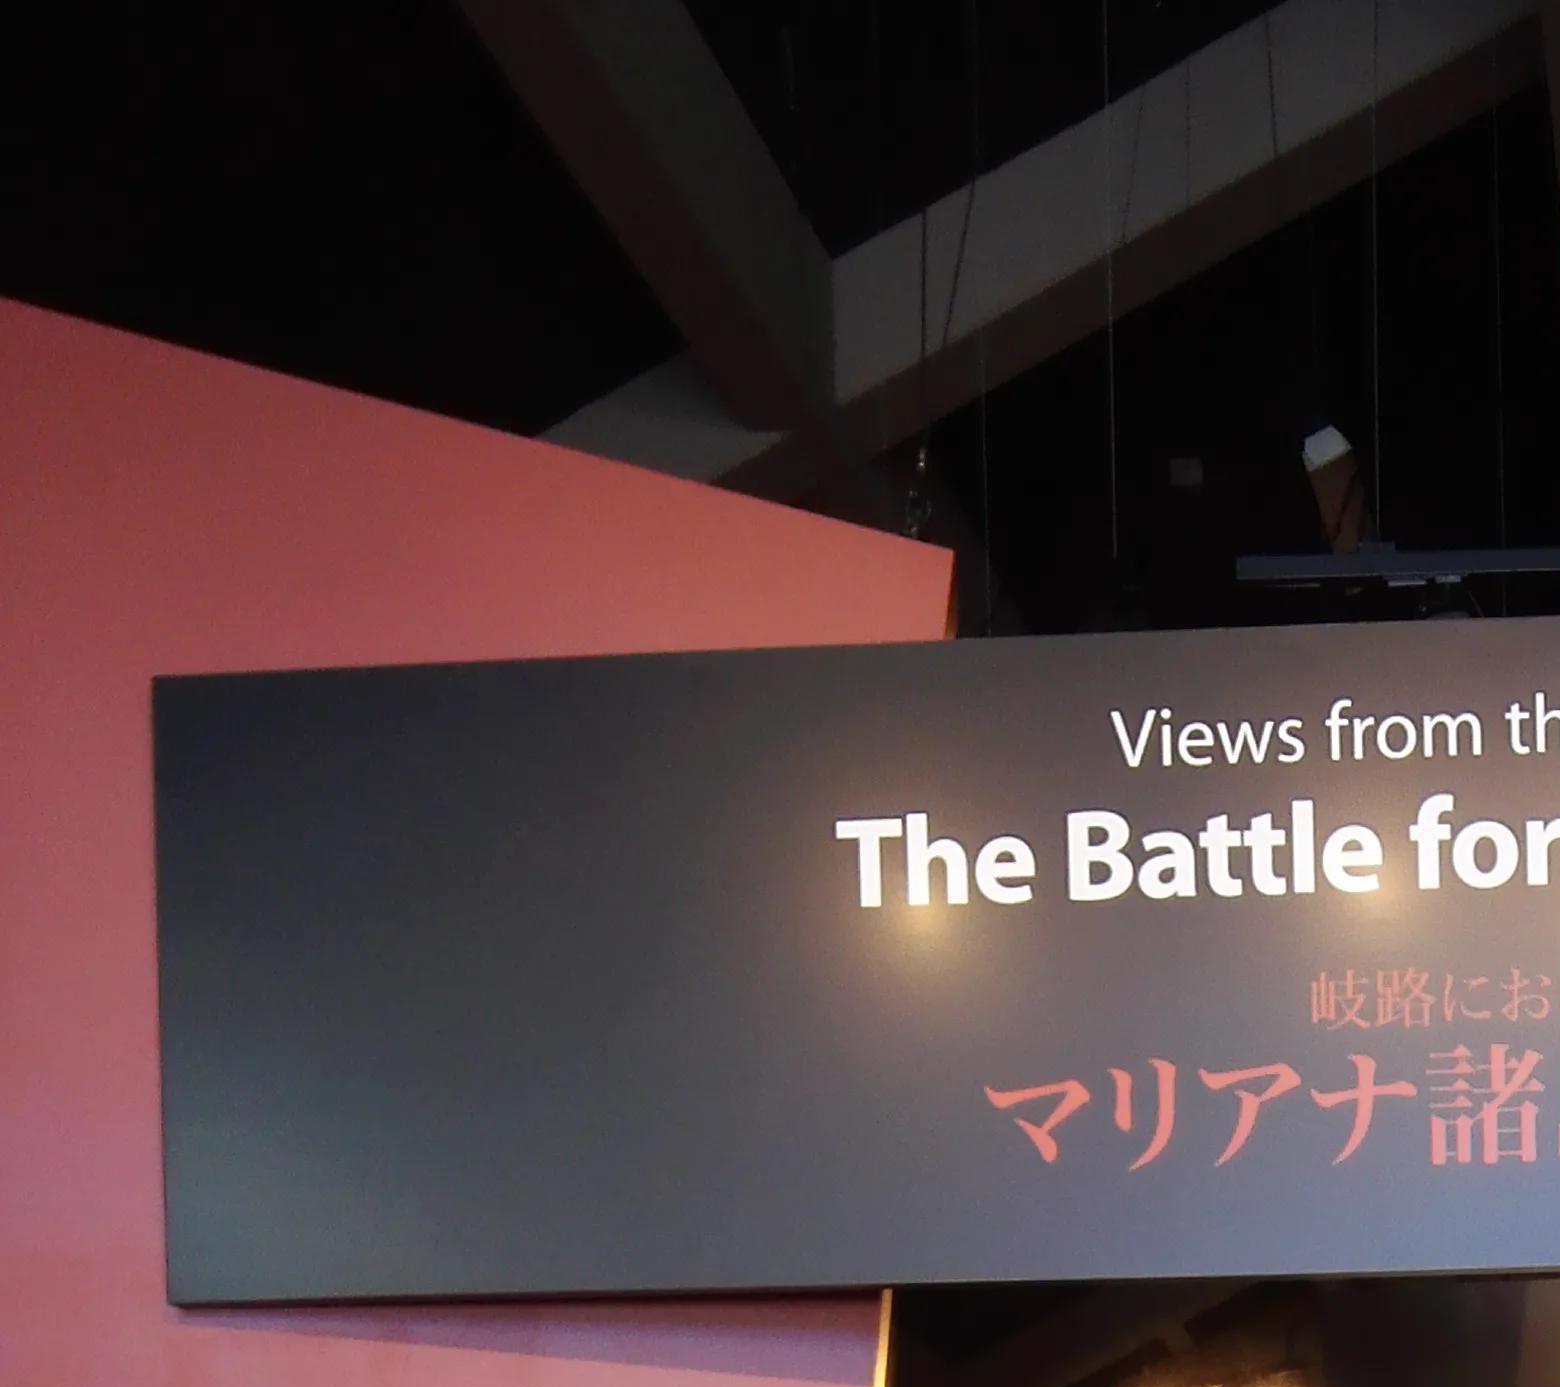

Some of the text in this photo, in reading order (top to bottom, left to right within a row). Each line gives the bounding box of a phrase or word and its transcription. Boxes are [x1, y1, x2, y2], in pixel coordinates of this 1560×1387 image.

[1110, 709, 1305, 767] Views
[1325, 699, 1482, 761] from
[835, 810, 1036, 911] The
[1067, 801, 1383, 901] Battle
